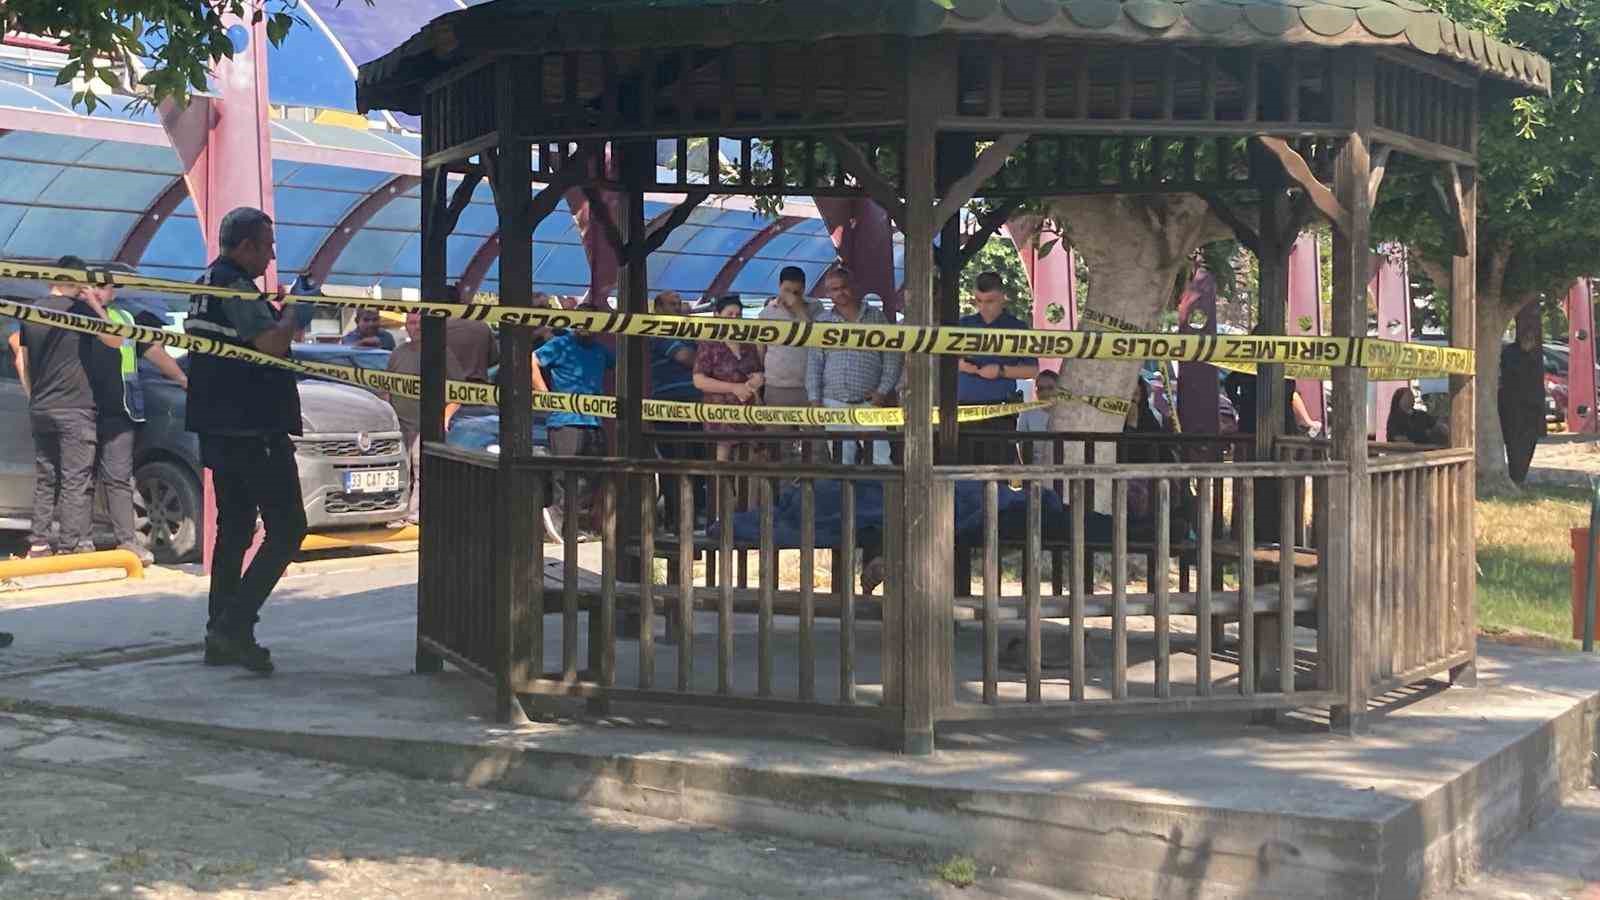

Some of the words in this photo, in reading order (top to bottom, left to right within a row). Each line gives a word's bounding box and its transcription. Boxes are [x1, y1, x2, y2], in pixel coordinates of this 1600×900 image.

[821, 328, 905, 349] POLİS
[945, 332, 1074, 355] GİRİLMEZ
[1112, 338, 1188, 358] POLİS
[1223, 340, 1341, 360] GİRİLMEZ
